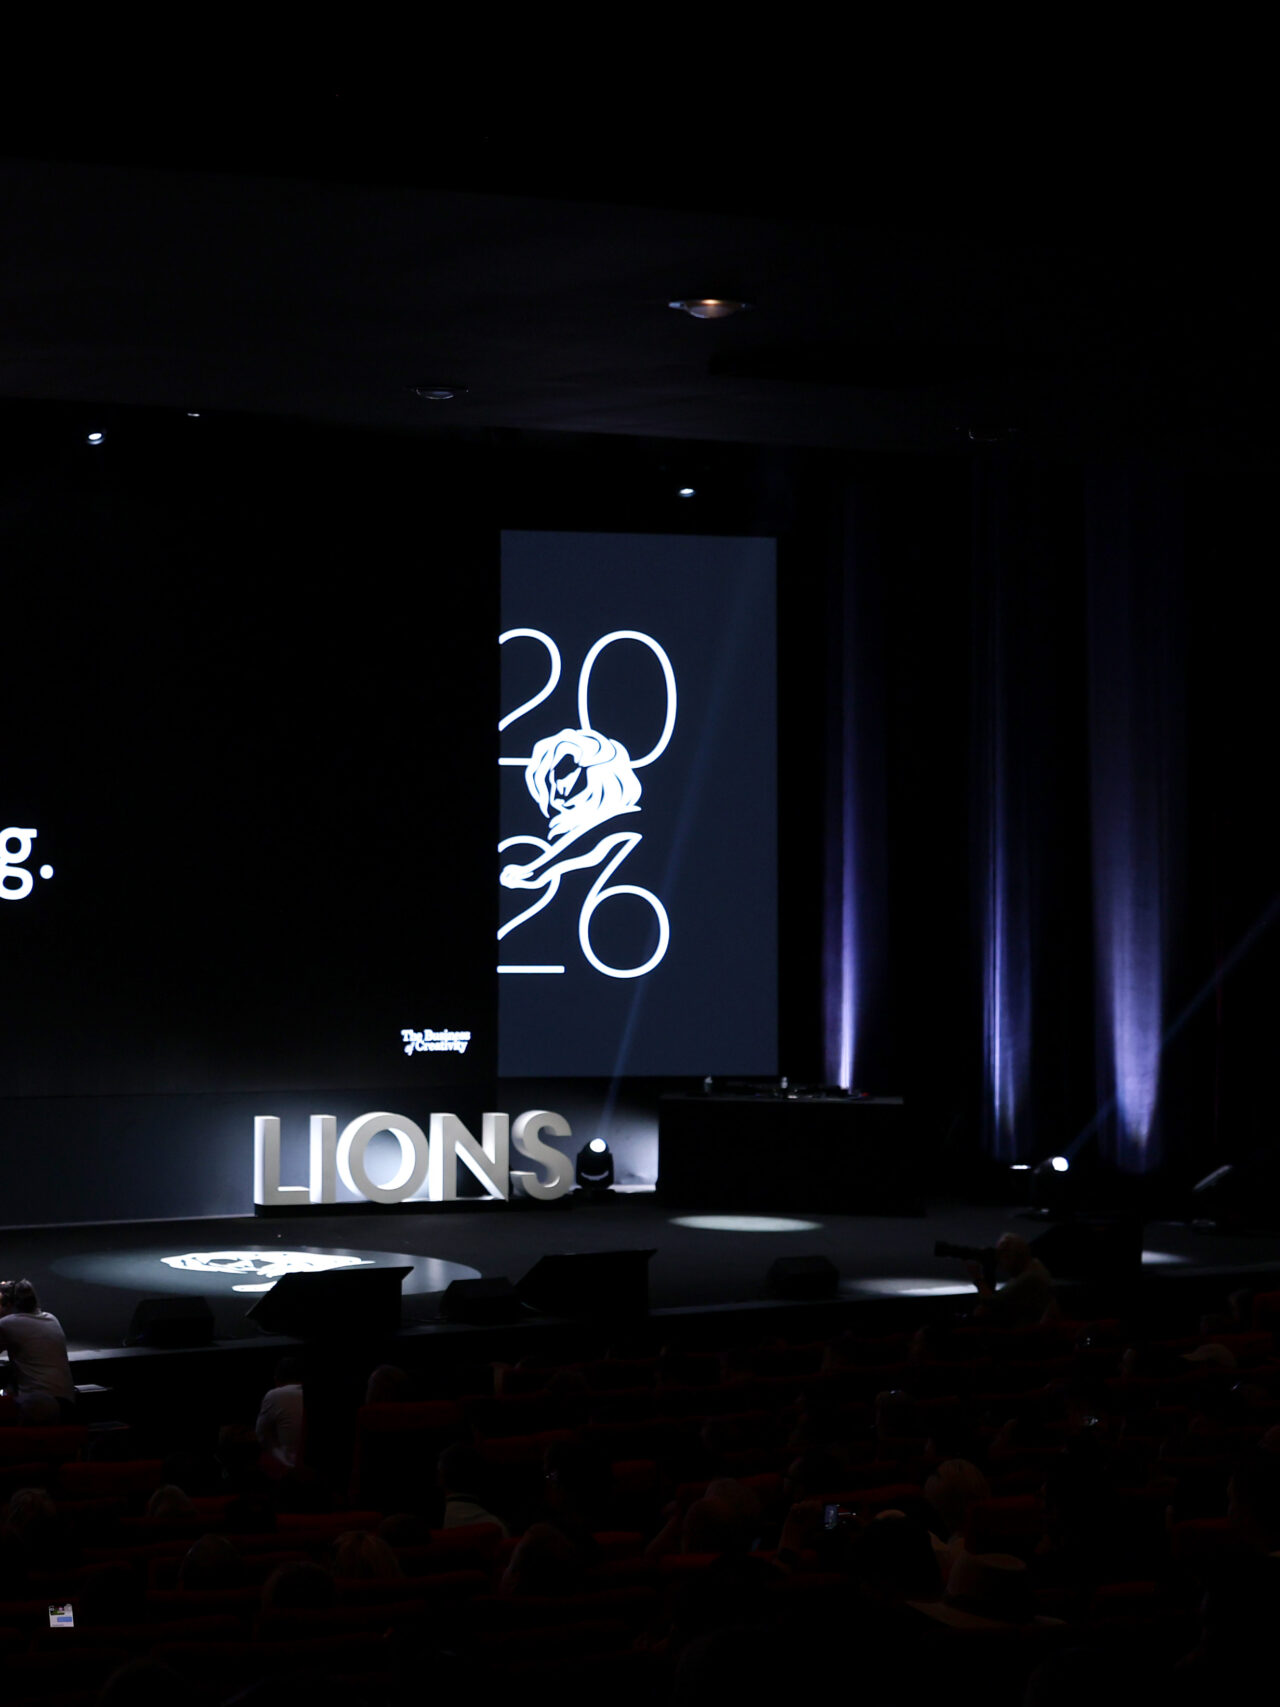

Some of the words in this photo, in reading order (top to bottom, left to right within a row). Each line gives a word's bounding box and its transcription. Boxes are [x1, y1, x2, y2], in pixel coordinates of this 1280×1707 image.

[400, 1029, 423, 1042] The
[423, 1029, 471, 1041] Business
[415, 1041, 468, 1054] Creativity
[253, 1109, 573, 1204] LIONS
